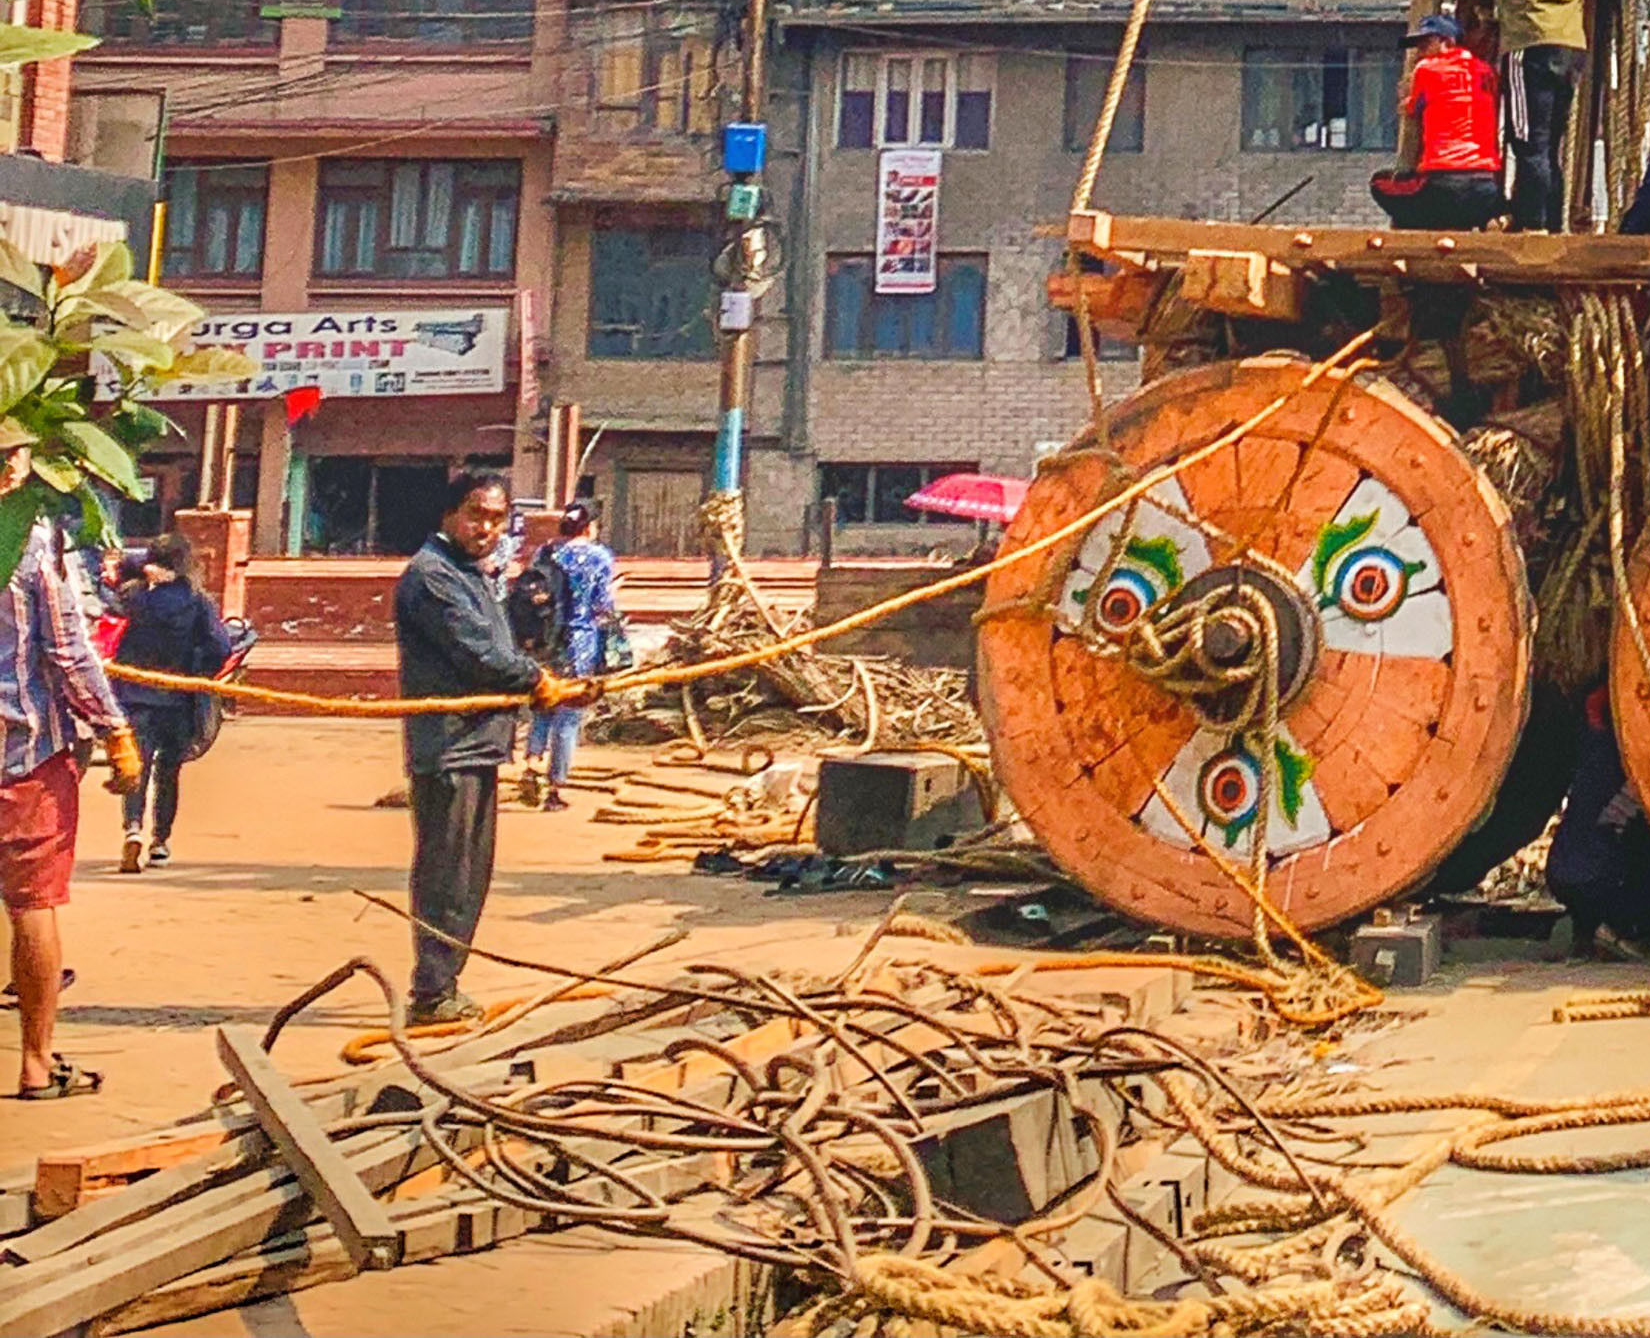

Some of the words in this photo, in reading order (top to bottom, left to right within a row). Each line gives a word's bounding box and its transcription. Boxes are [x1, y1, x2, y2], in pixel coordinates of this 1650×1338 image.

[190, 321, 292, 339] urga
[311, 316, 398, 334] Arts
[262, 340, 410, 358] PRINT
